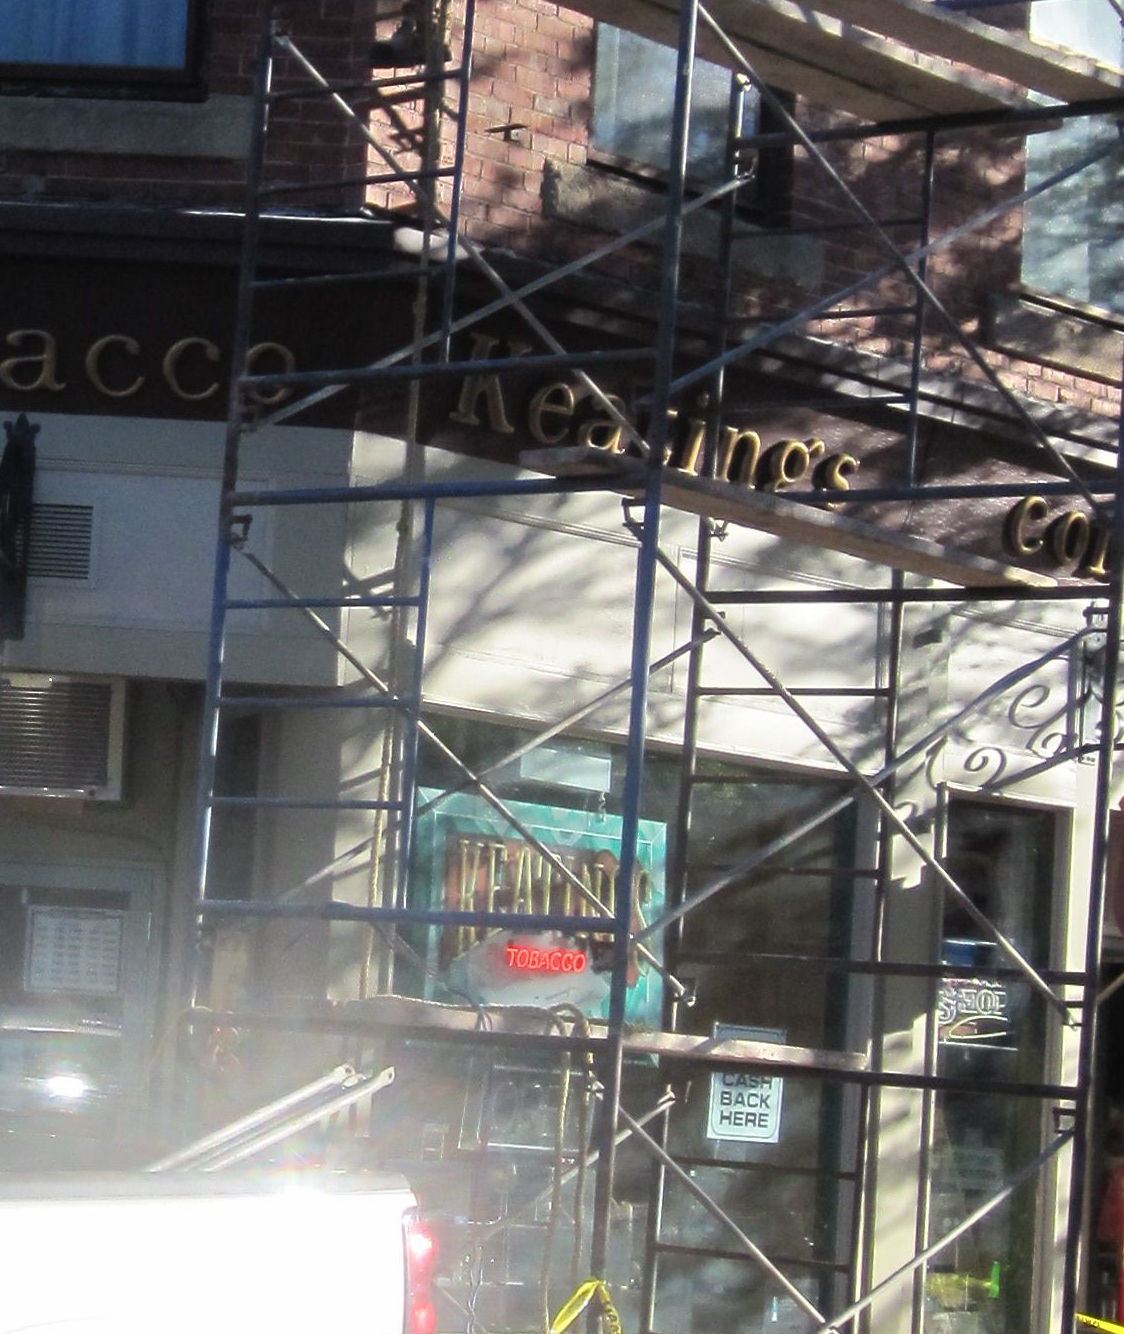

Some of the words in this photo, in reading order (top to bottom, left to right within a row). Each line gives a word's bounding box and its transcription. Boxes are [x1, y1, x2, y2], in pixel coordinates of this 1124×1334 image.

[507, 947, 587, 973] TOBACCO
[722, 1072, 772, 1089] CASH
[720, 1090, 771, 1109] BACK
[718, 1109, 769, 1128] HERE
